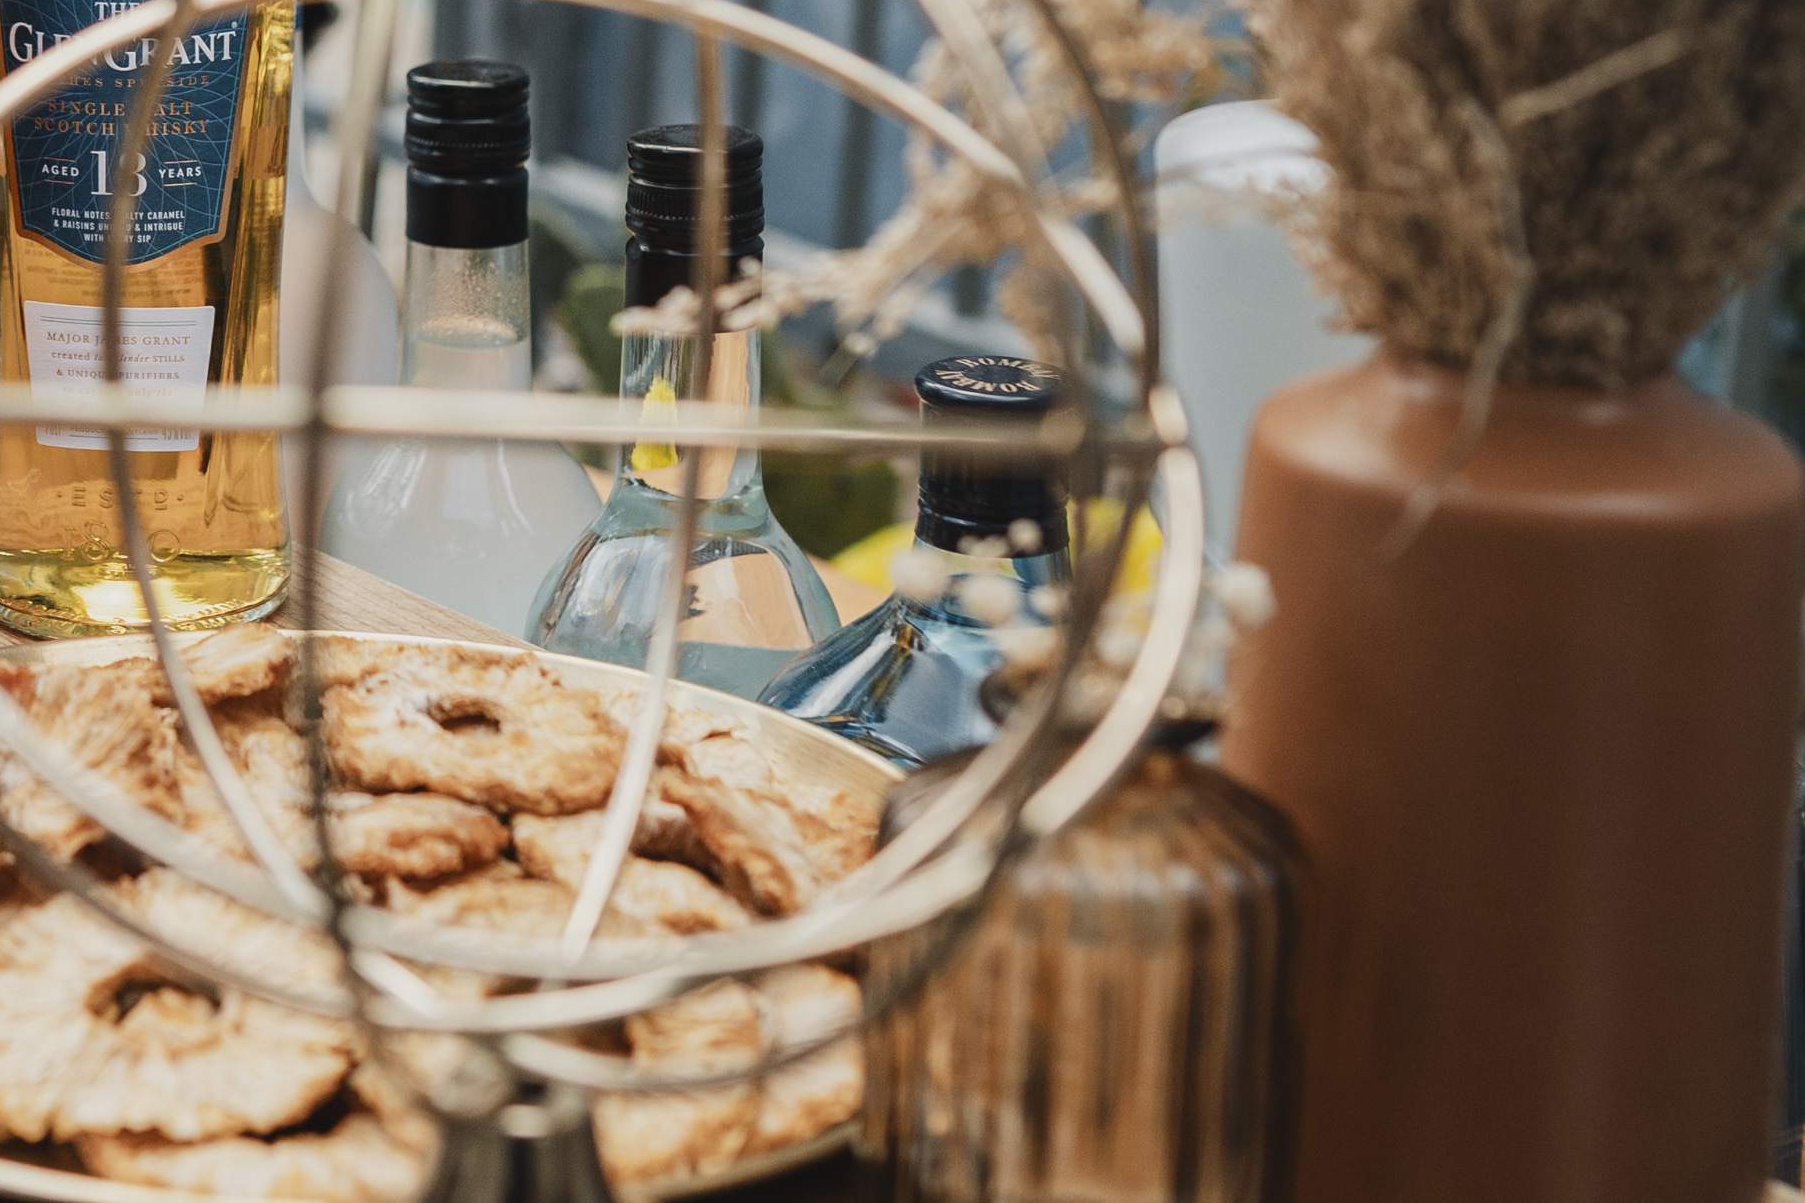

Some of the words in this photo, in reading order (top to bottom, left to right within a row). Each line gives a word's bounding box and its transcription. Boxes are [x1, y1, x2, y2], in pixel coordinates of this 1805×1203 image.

[48, 98, 126, 117] SINGLE
[34, 116, 115, 136] SCOTCH
[125, 118, 210, 136] HISKY
[41, 163, 80, 177] AGED
[158, 166, 202, 180] YEARS
[52, 207, 80, 218] FLORAL
[84, 210, 110, 220] NOTES
[147, 210, 185, 220] CARAMEL
[53, 219, 60, 228] &
[62, 220, 95, 231] RAISINS
[134, 223, 141, 232] &
[144, 222, 183, 232] INTRIGUE
[83, 233, 104, 242] WITH
[137, 234, 152, 243] SIP
[46, 331, 90, 345] MAJOR
[142, 336, 191, 346] GRANT
[51, 351, 90, 361] created
[119, 353, 150, 362] lender
[152, 354, 185, 363] STILLS
[67, 369, 108, 380] UNIQU
[119, 372, 180, 380] PURIFIERS
